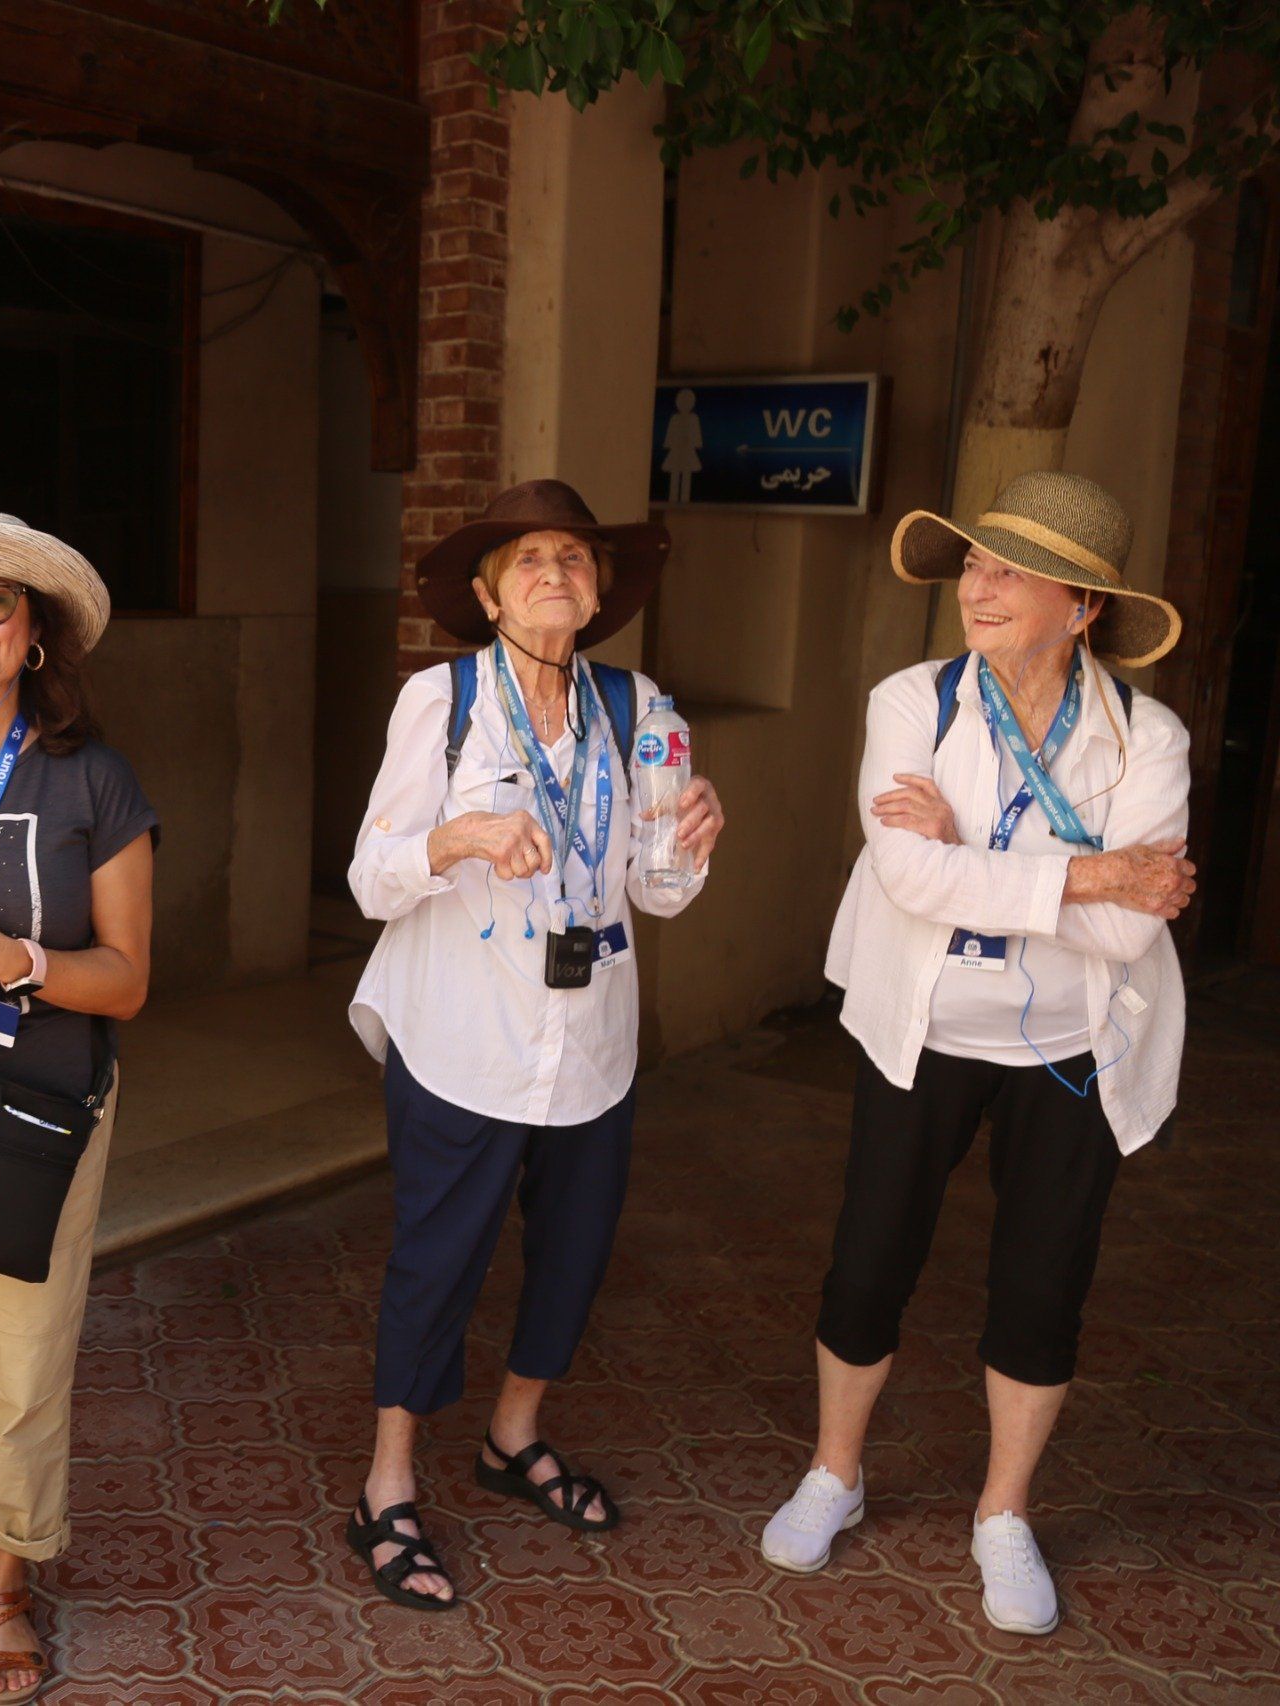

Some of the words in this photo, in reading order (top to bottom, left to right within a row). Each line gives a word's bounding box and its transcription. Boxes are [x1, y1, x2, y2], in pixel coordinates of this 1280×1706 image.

[762, 407, 833, 439] WC
[597, 793, 610, 829] Tours
[600, 957, 616, 968] Mary
[960, 958, 983, 968] Anne
